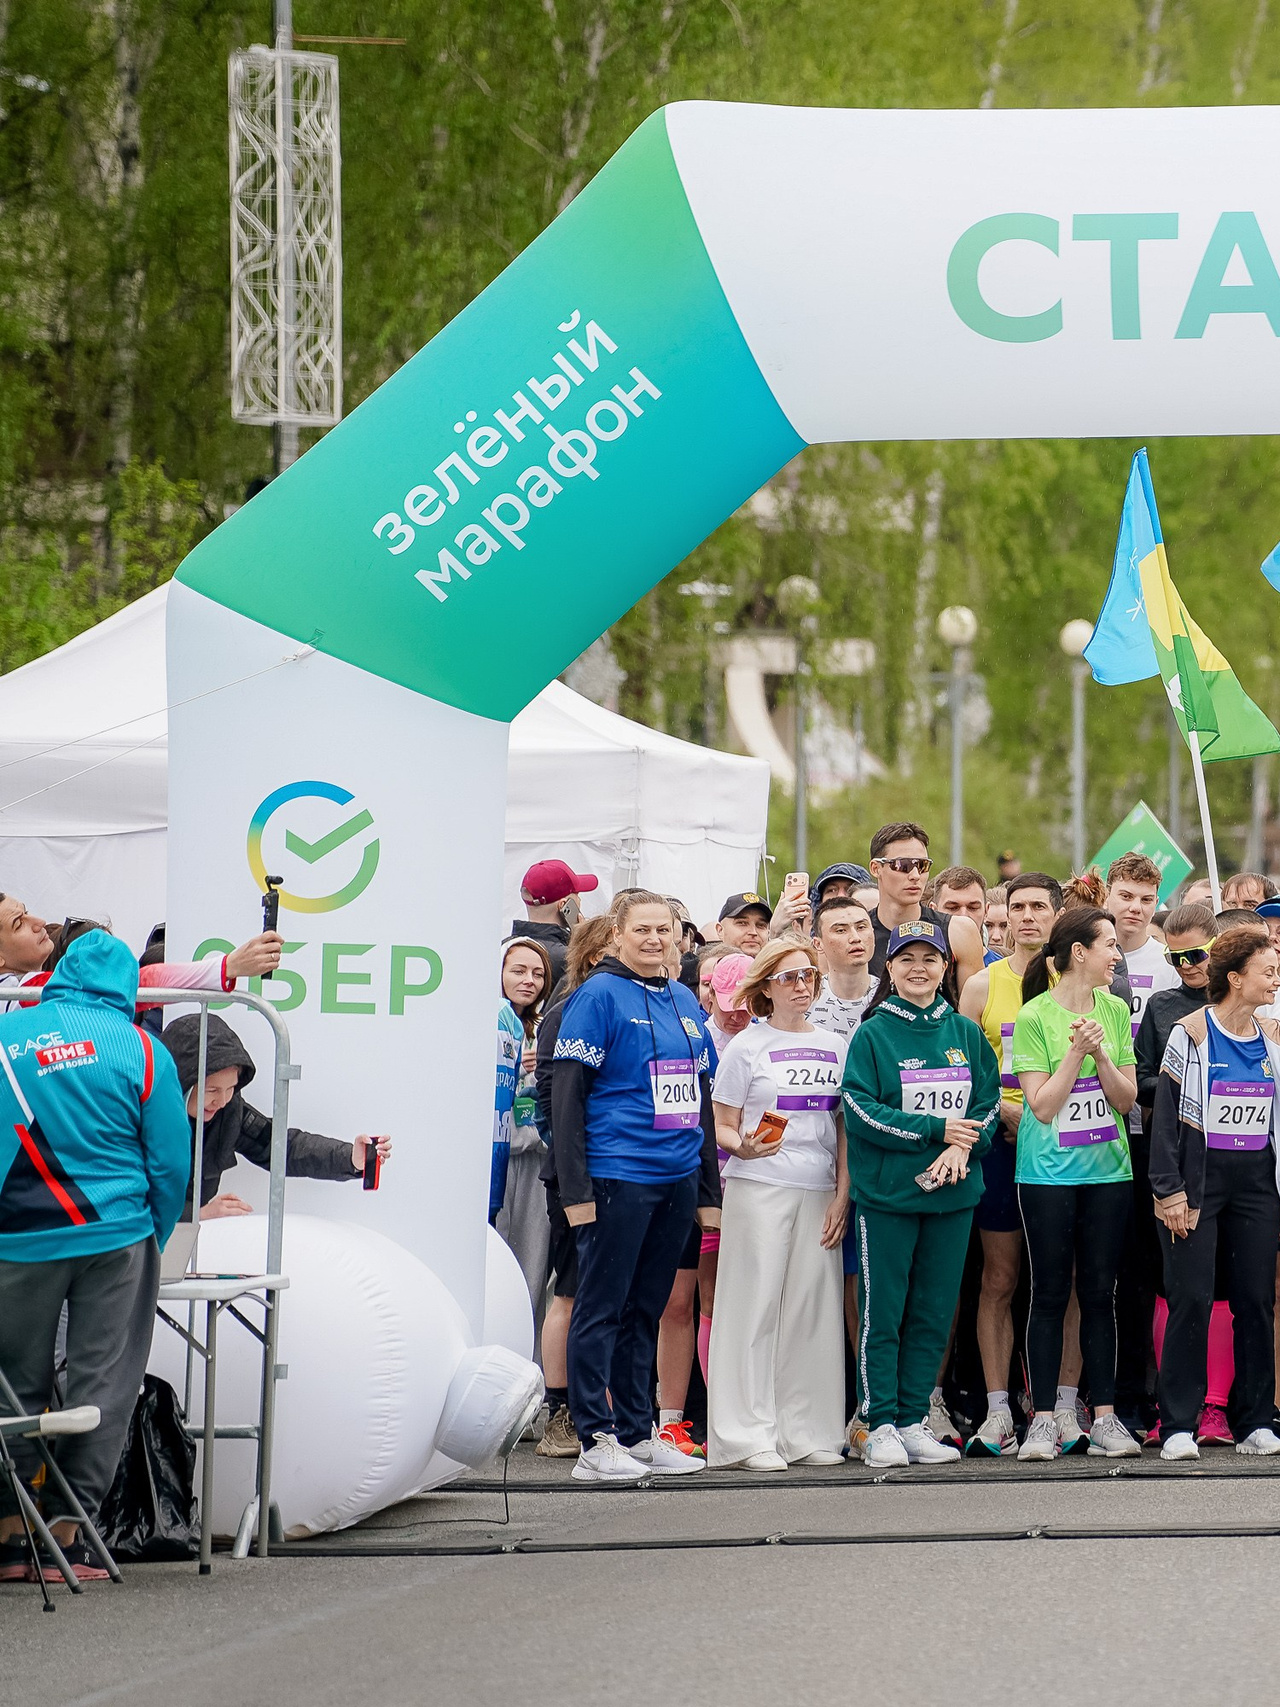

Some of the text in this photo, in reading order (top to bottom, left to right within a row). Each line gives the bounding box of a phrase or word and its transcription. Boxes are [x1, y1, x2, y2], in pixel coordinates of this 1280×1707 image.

[371, 308, 619, 556] зелёный
[413, 366, 663, 603] марафон
[8, 1031, 65, 1060] RACE
[43, 1043, 87, 1063] TIME
[37, 1063, 65, 1077] ВРЕМЯ
[786, 1068, 838, 1086] 2244
[914, 1090, 963, 1110] 2186
[1218, 1105, 1267, 1125] 2074
